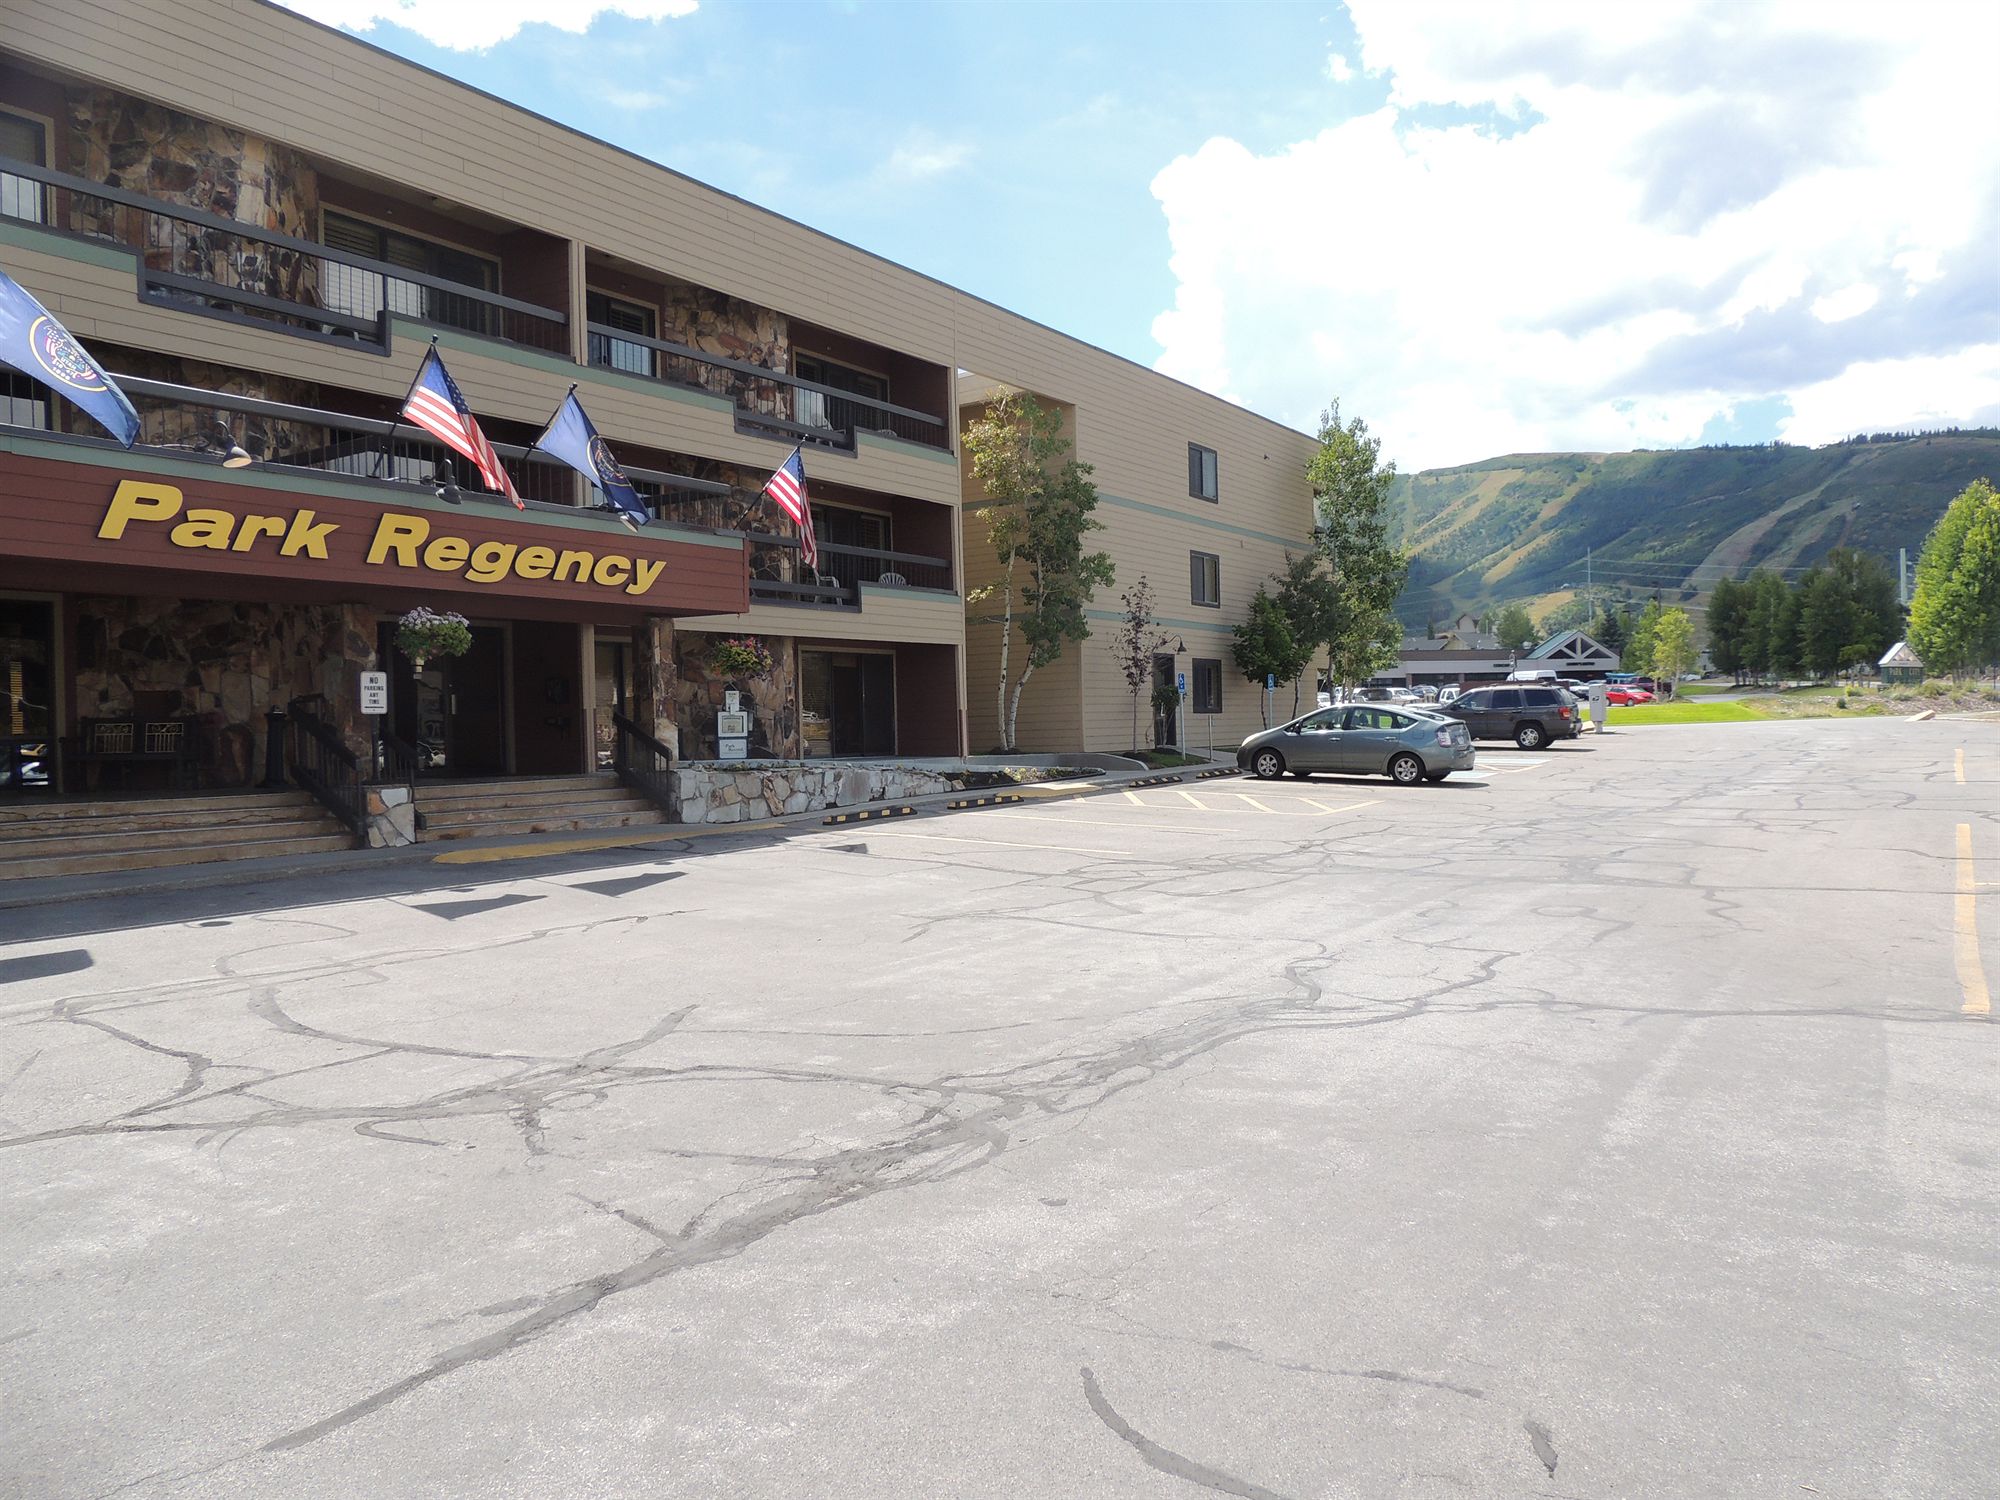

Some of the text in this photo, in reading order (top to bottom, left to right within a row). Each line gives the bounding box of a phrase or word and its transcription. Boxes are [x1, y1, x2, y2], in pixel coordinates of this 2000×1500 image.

[61, 357, 76, 369] UTAH
[97, 479, 667, 595] Park Regency
[369, 676, 379, 684] NO
